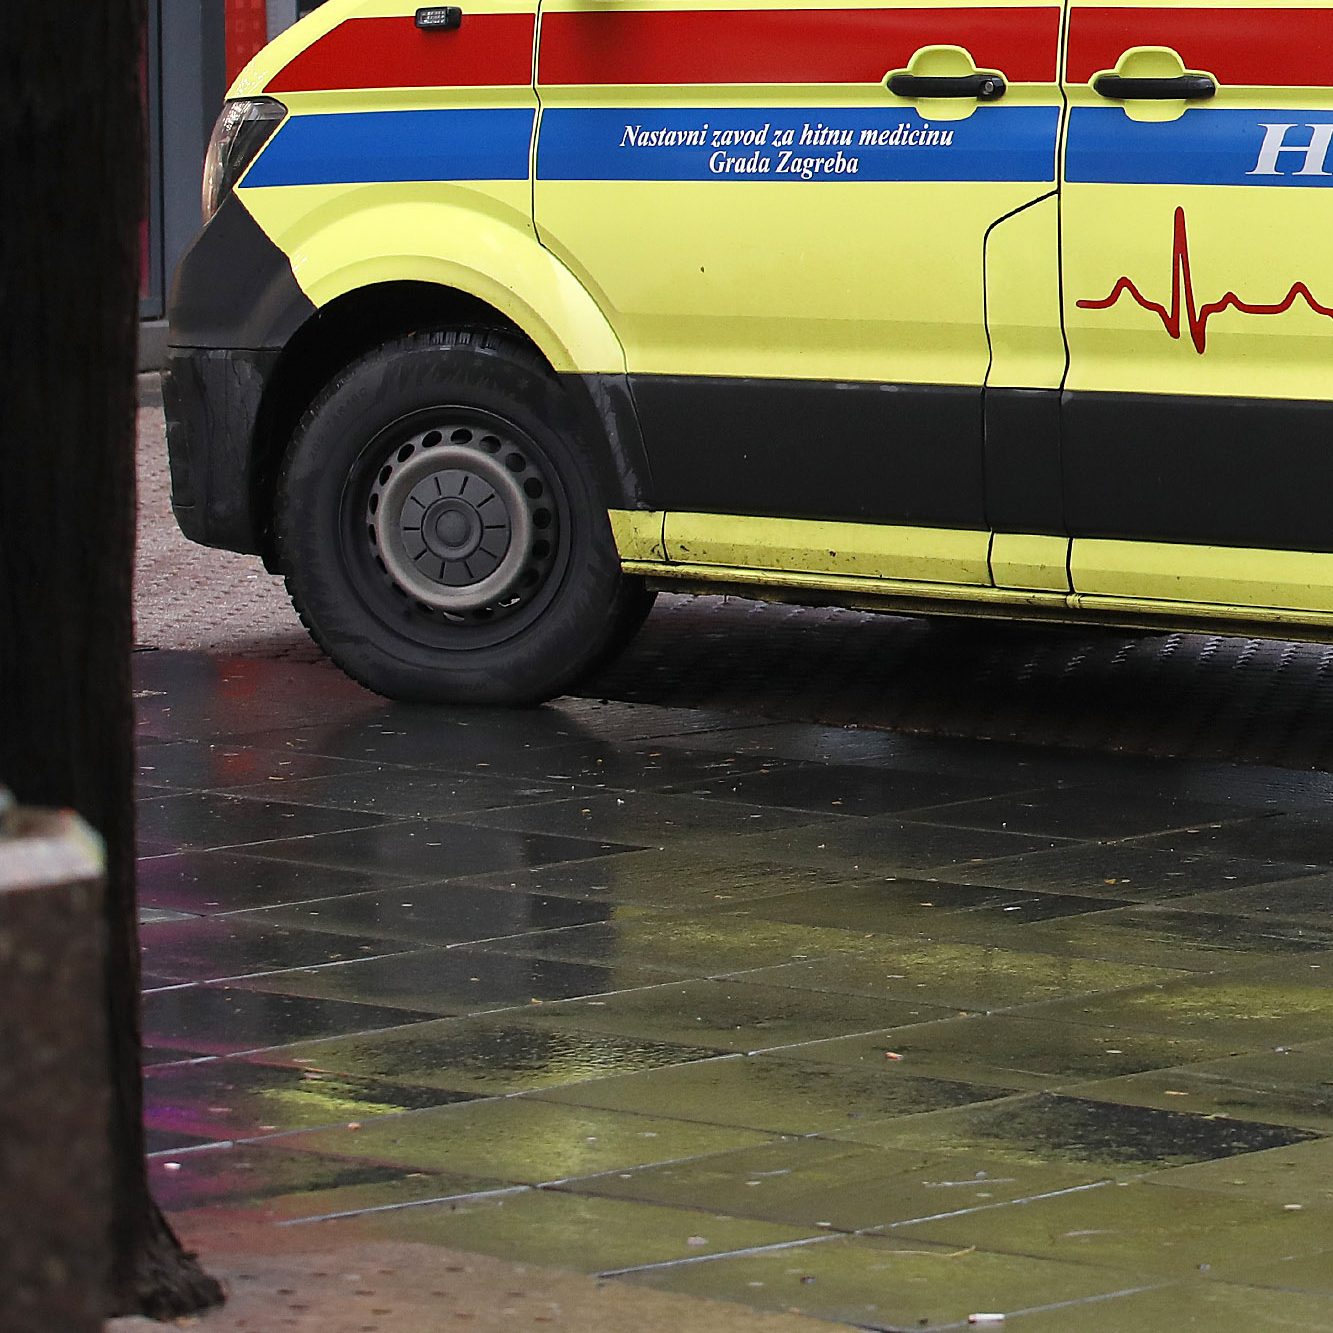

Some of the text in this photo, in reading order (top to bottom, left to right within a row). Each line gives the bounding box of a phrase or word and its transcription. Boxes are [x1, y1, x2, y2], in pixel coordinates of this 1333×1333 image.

[619, 122, 954, 147] Nastavni zavod za hitnu medicinu
[708, 150, 859, 178] Grada Zagreba
